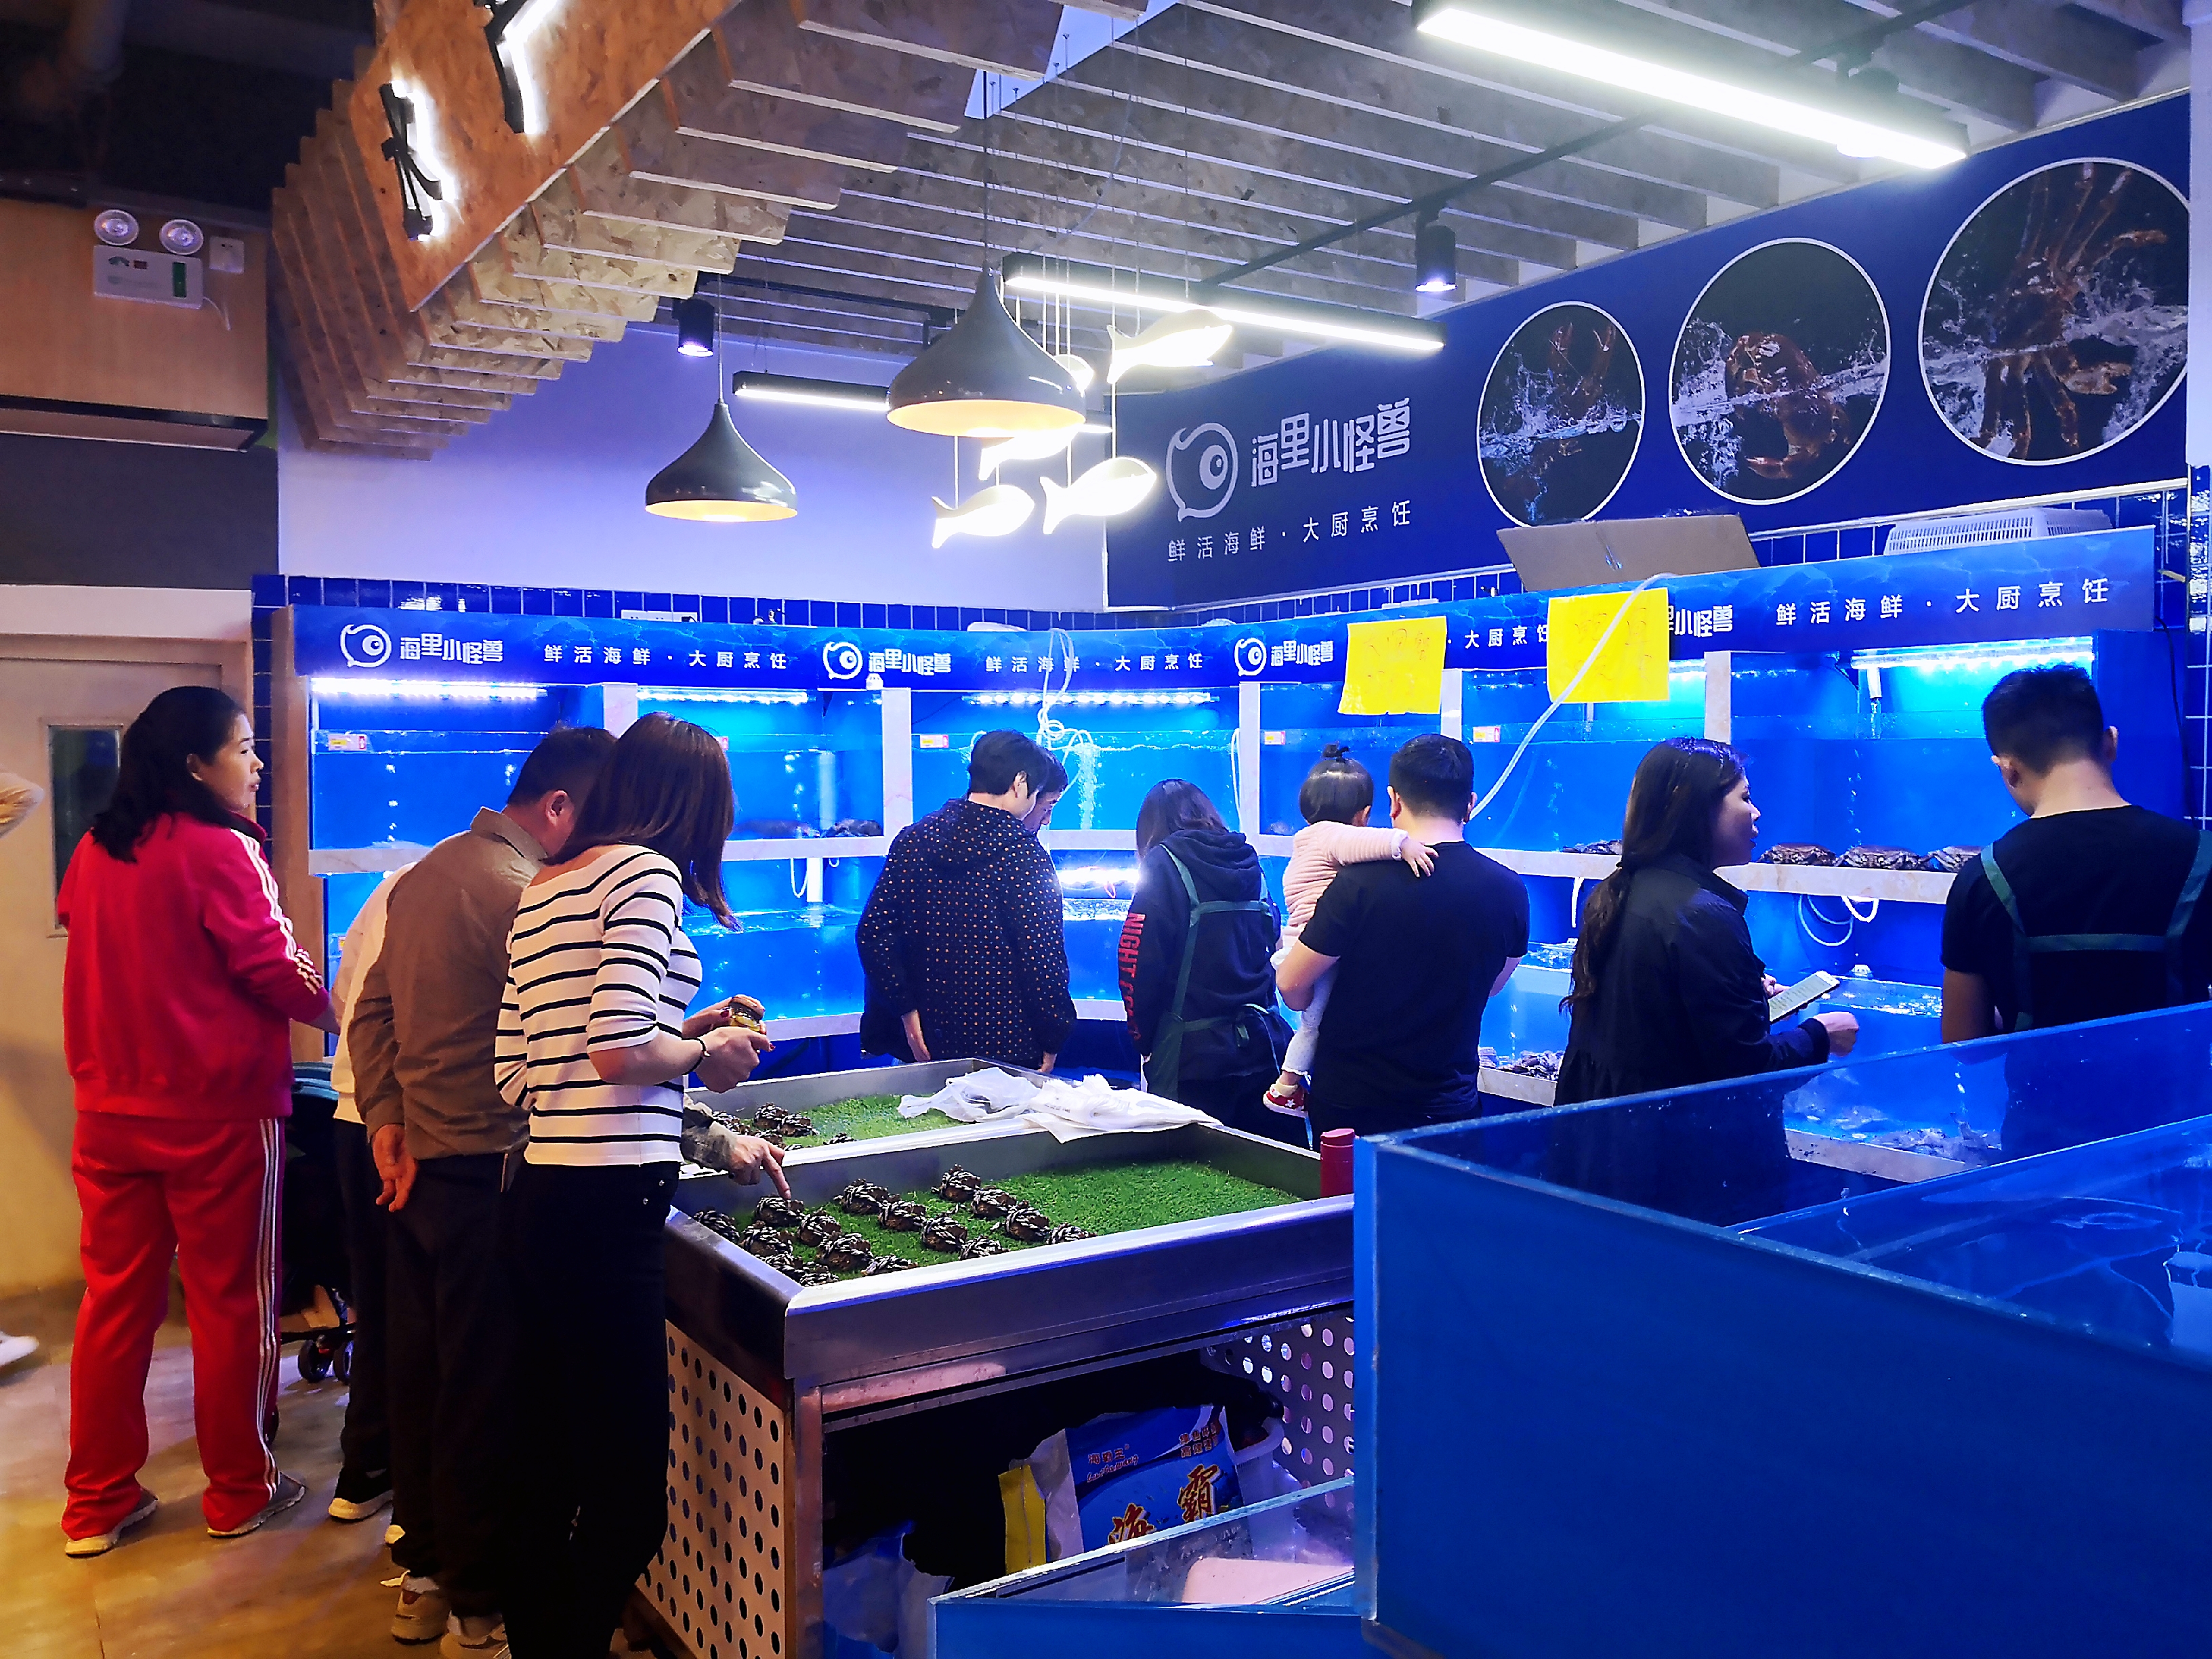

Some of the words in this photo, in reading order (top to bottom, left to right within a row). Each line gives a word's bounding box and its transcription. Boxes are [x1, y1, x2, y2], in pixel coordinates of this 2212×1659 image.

[1251, 397, 1411, 487] 海里小怪兽
[400, 633, 504, 665] 海里小怪兽
[868, 648, 952, 676] 海里小怪兽
[1270, 640, 1333, 666] 海里小怪兽
[1119, 912, 1146, 978] NIGHT
